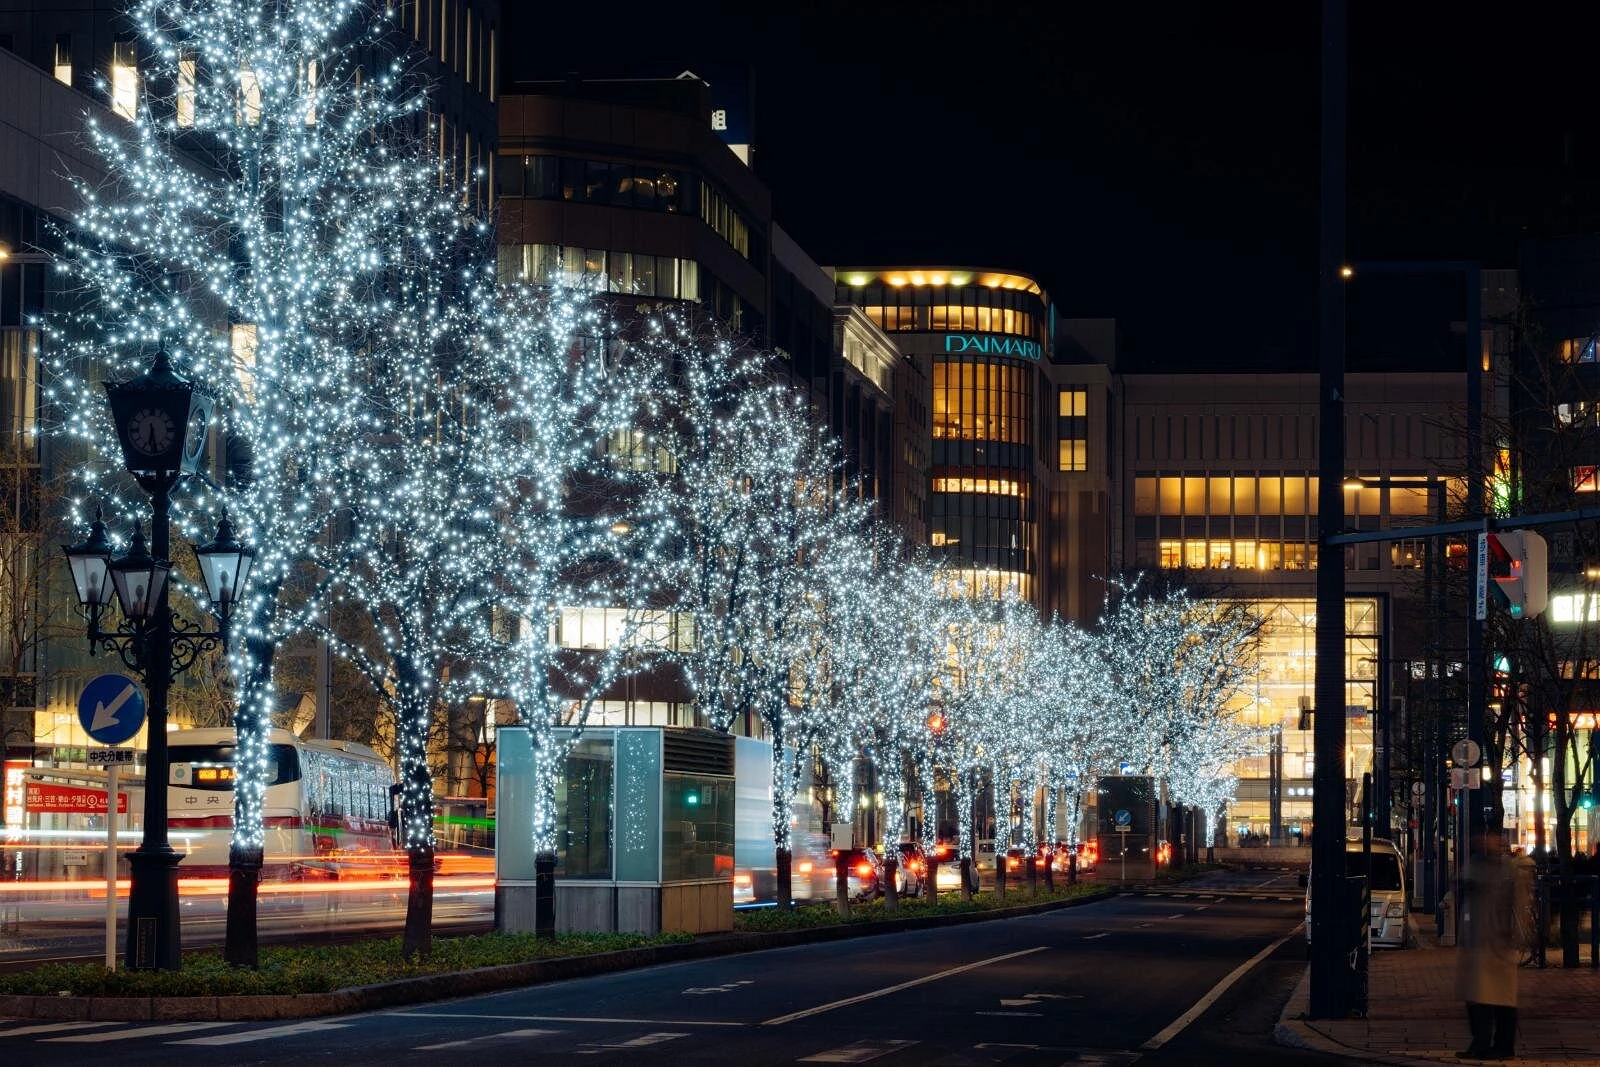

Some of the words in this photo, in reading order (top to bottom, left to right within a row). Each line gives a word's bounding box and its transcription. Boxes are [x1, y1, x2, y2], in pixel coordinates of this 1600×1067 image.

[945, 335, 1041, 360] DAIMARU
[90, 750, 133, 762] 中央分離帯
[185, 796, 234, 805] 中央
